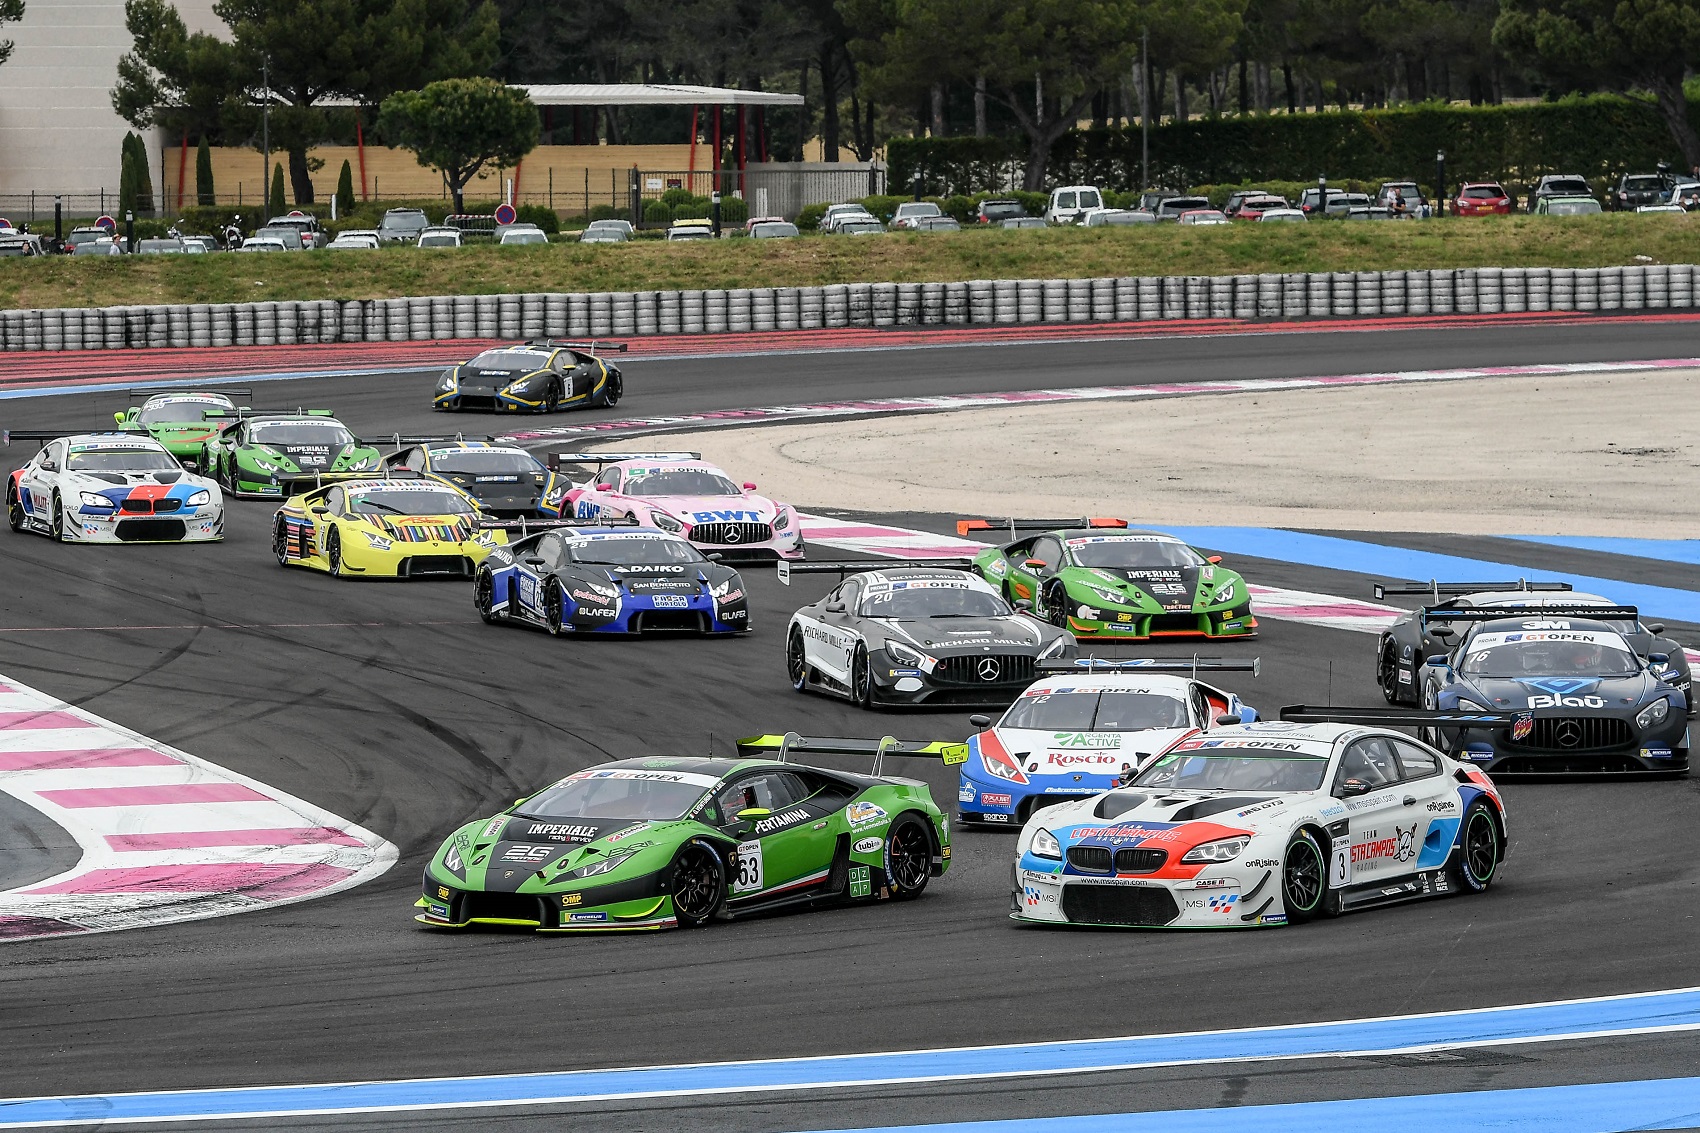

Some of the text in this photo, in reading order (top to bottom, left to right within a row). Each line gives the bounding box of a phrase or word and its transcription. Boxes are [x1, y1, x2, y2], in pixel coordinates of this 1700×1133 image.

[577, 500, 600, 519] BWT
[692, 510, 760, 523] BWT
[570, 541, 588, 549] 28
[630, 565, 684, 573] DAIKO
[1126, 570, 1182, 579] IMPERIALE
[874, 592, 893, 605] 20
[585, 607, 616, 617] LAFER
[727, 609, 747, 619] LAFER
[1521, 620, 1571, 630] 3M
[1526, 633, 1595, 643] GTOPEN
[931, 638, 1033, 649] RICHARD MILLE
[1468, 650, 1491, 664] 16
[1030, 696, 1051, 705] 12
[1222, 741, 1301, 751] GTOPEN
[612, 772, 684, 782] GTOPEN
[983, 813, 1008, 822] sparco
[527, 823, 599, 838] IMPERIALE
[1363, 829, 1378, 840] TEAM
[738, 843, 759, 852] GTOPEN
[858, 840, 874, 851] tubi
[739, 856, 759, 886] 63
[1339, 852, 1346, 880] 3
[1356, 861, 1378, 873] RACING
[1080, 877, 1148, 887] www.msispain.com
[562, 895, 582, 905] OMP
